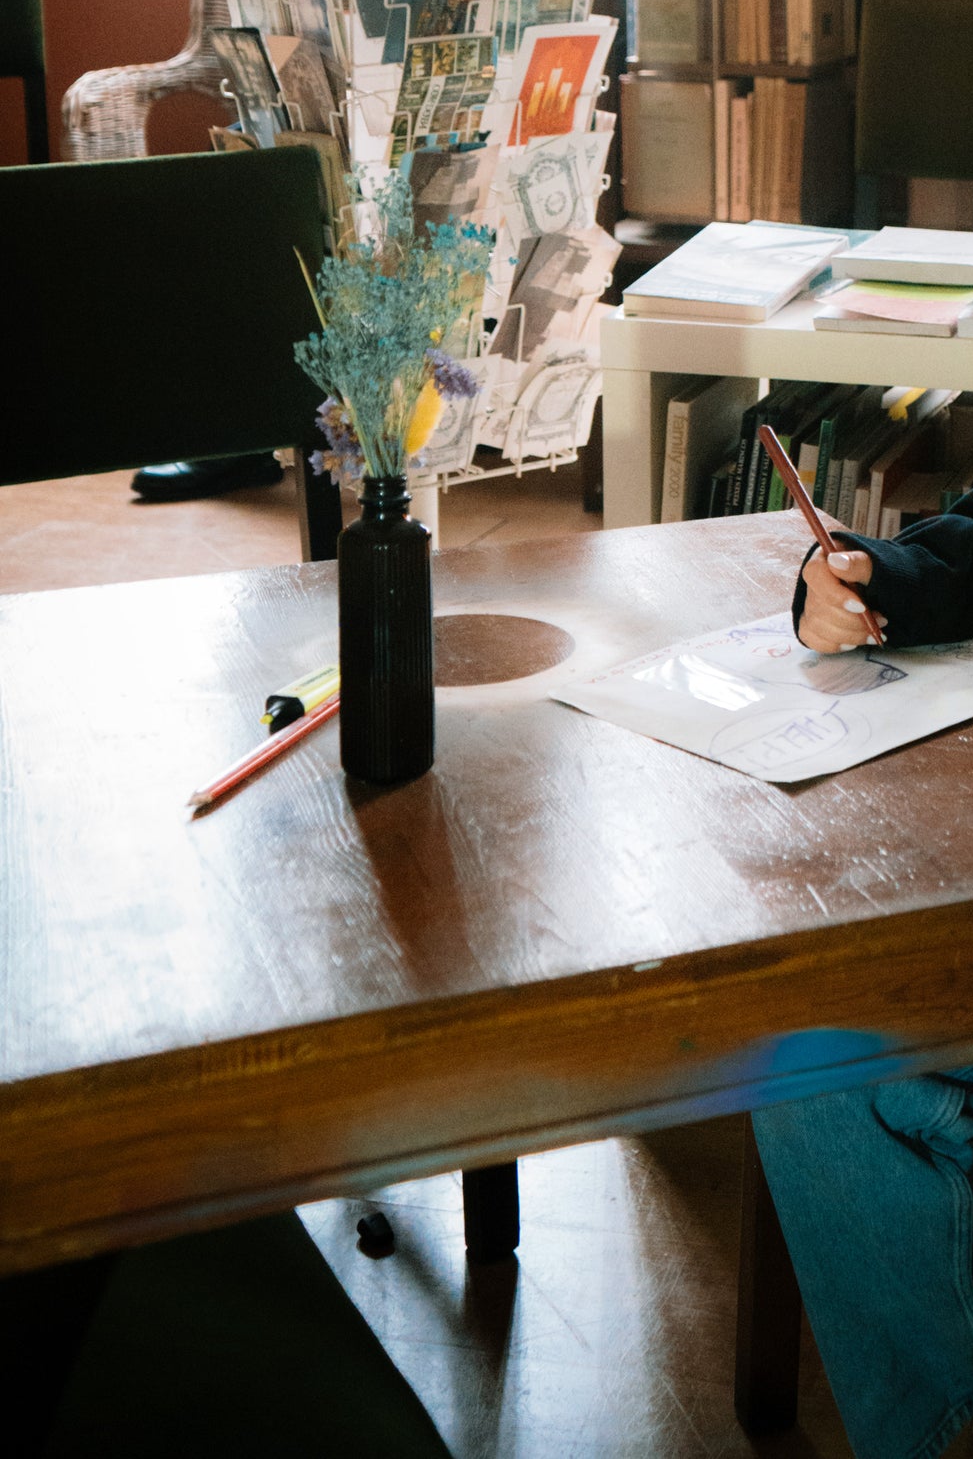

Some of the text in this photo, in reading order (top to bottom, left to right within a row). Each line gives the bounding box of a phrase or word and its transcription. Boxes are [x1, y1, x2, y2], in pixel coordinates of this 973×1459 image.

[668, 415, 688, 499] family 2000
[733, 481, 742, 507] PEIXES
